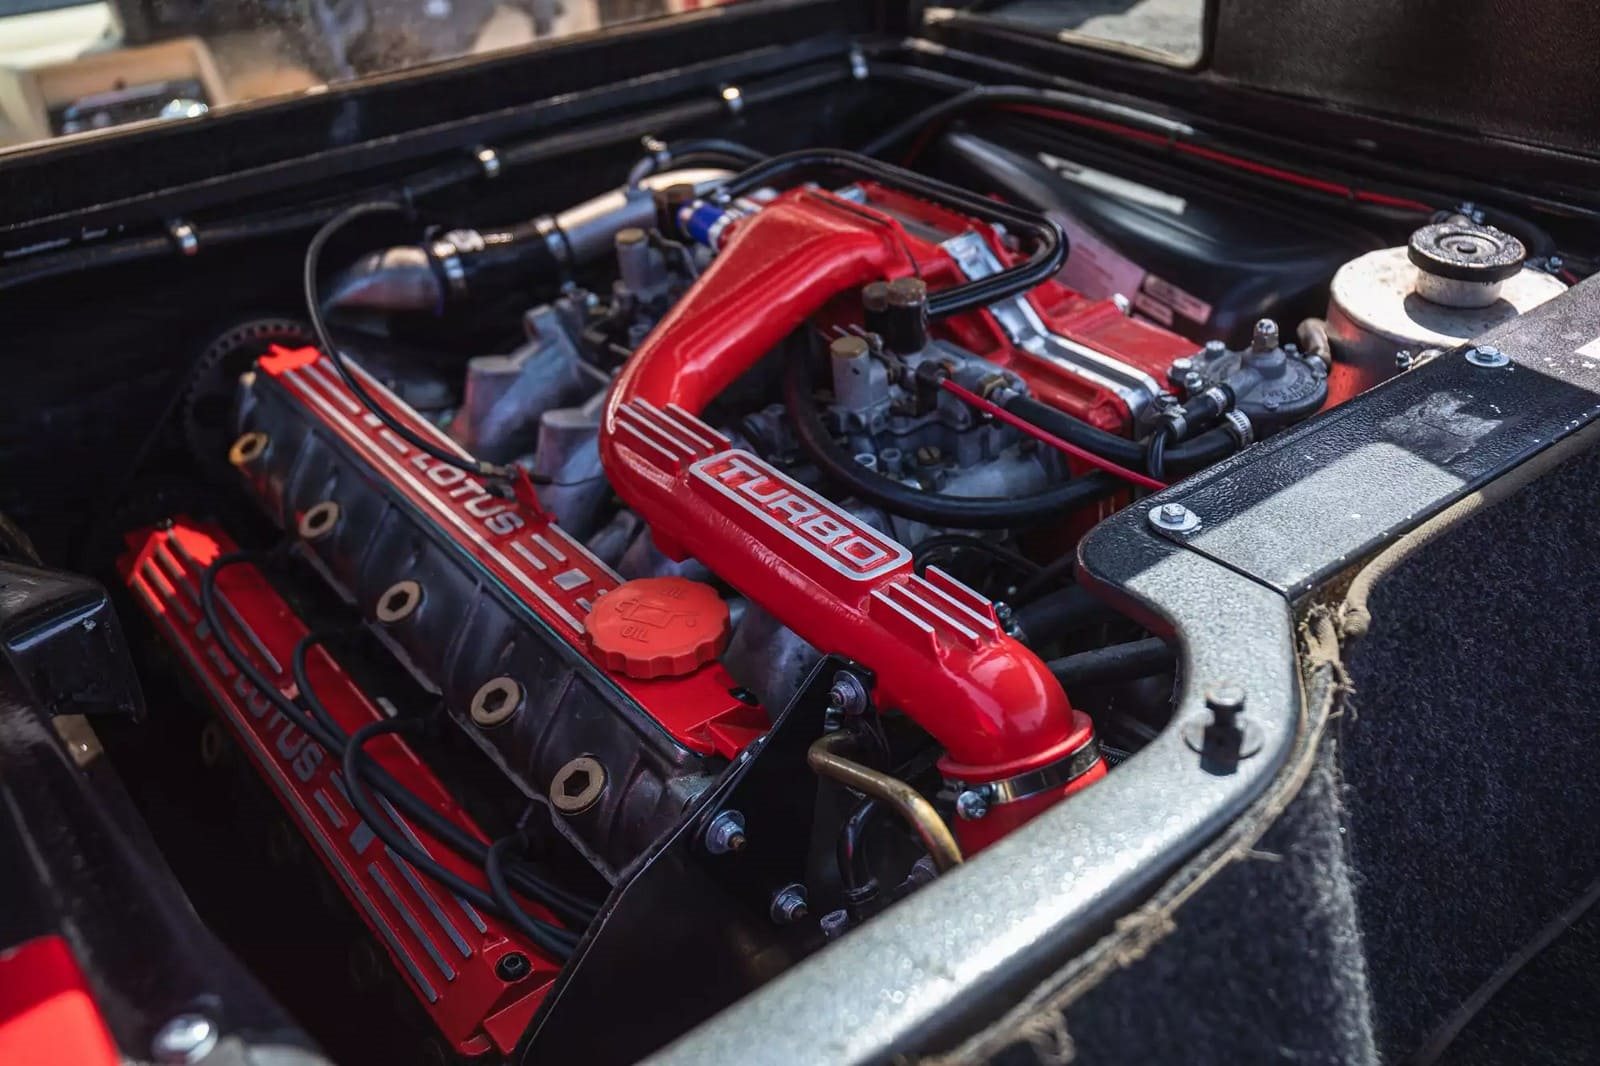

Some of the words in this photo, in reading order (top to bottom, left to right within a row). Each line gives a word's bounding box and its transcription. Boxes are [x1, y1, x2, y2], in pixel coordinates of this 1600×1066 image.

[411, 453, 525, 535] LOTUS
[719, 458, 888, 567] TURBO
[620, 624, 649, 644] OIL
